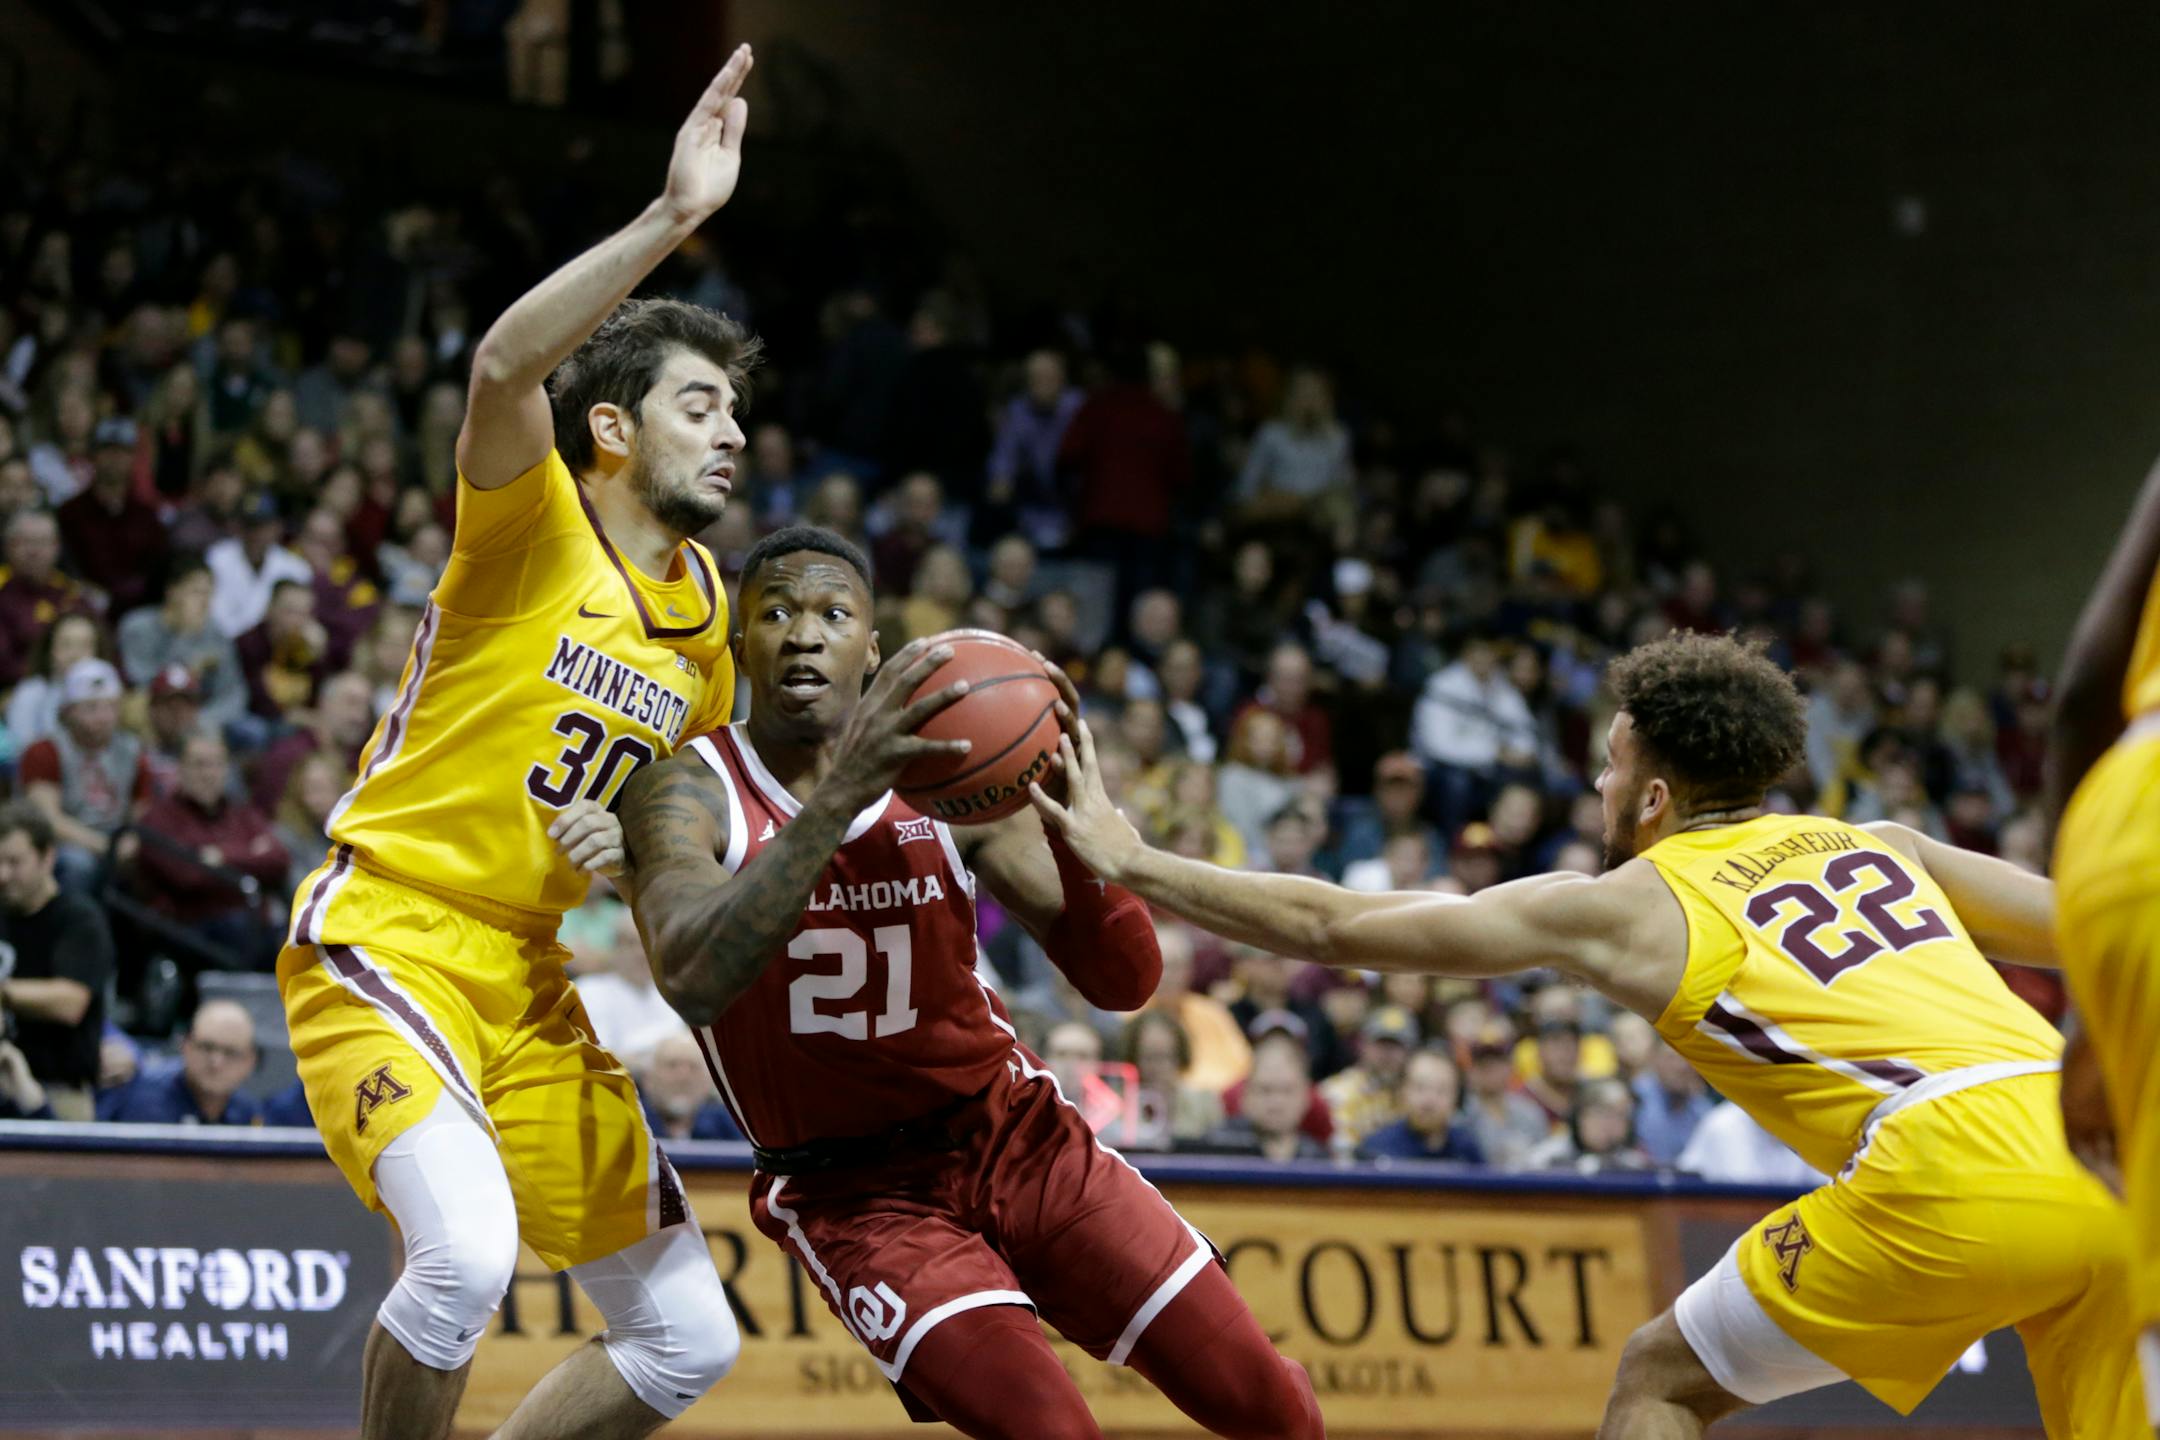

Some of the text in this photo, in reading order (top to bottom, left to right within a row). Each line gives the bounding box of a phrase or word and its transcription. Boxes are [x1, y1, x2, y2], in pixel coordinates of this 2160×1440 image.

[544, 634, 691, 746] MINNESOTA
[524, 711, 656, 812] 30
[932, 750, 1050, 818] Wilson
[803, 874, 944, 912] LAHOMA
[1712, 831, 1861, 893] KALSCHEUR
[1744, 849, 1956, 987] 22
[787, 923, 918, 1040] 21
[20, 1246, 350, 1312] SANFORD
[1224, 1238, 1611, 1349] COURT
[90, 1321, 289, 1361] HEALTH
[799, 1355, 1436, 1396] SIO AKOTA
